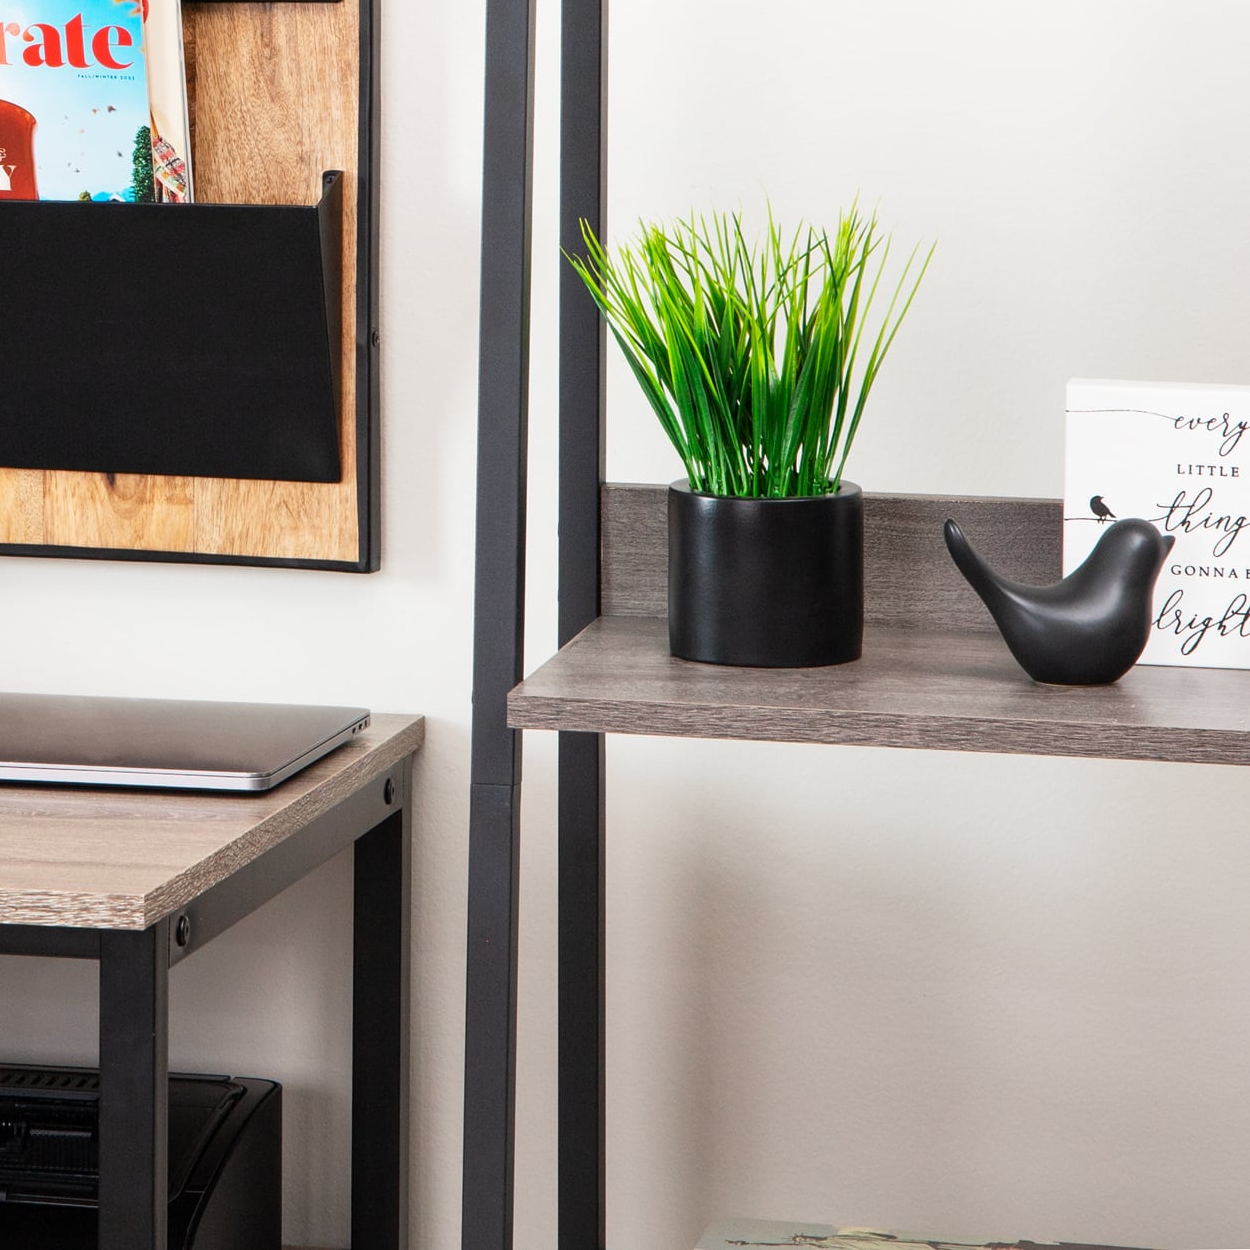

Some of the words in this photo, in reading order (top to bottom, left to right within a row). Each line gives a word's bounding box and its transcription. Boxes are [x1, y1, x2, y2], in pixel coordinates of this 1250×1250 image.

[1174, 412, 1250, 457] every
[1176, 463, 1240, 477] LITTLE
[1156, 487, 1250, 558] thing
[1170, 564, 1239, 579] GONNA
[1152, 589, 1250, 656] lright
